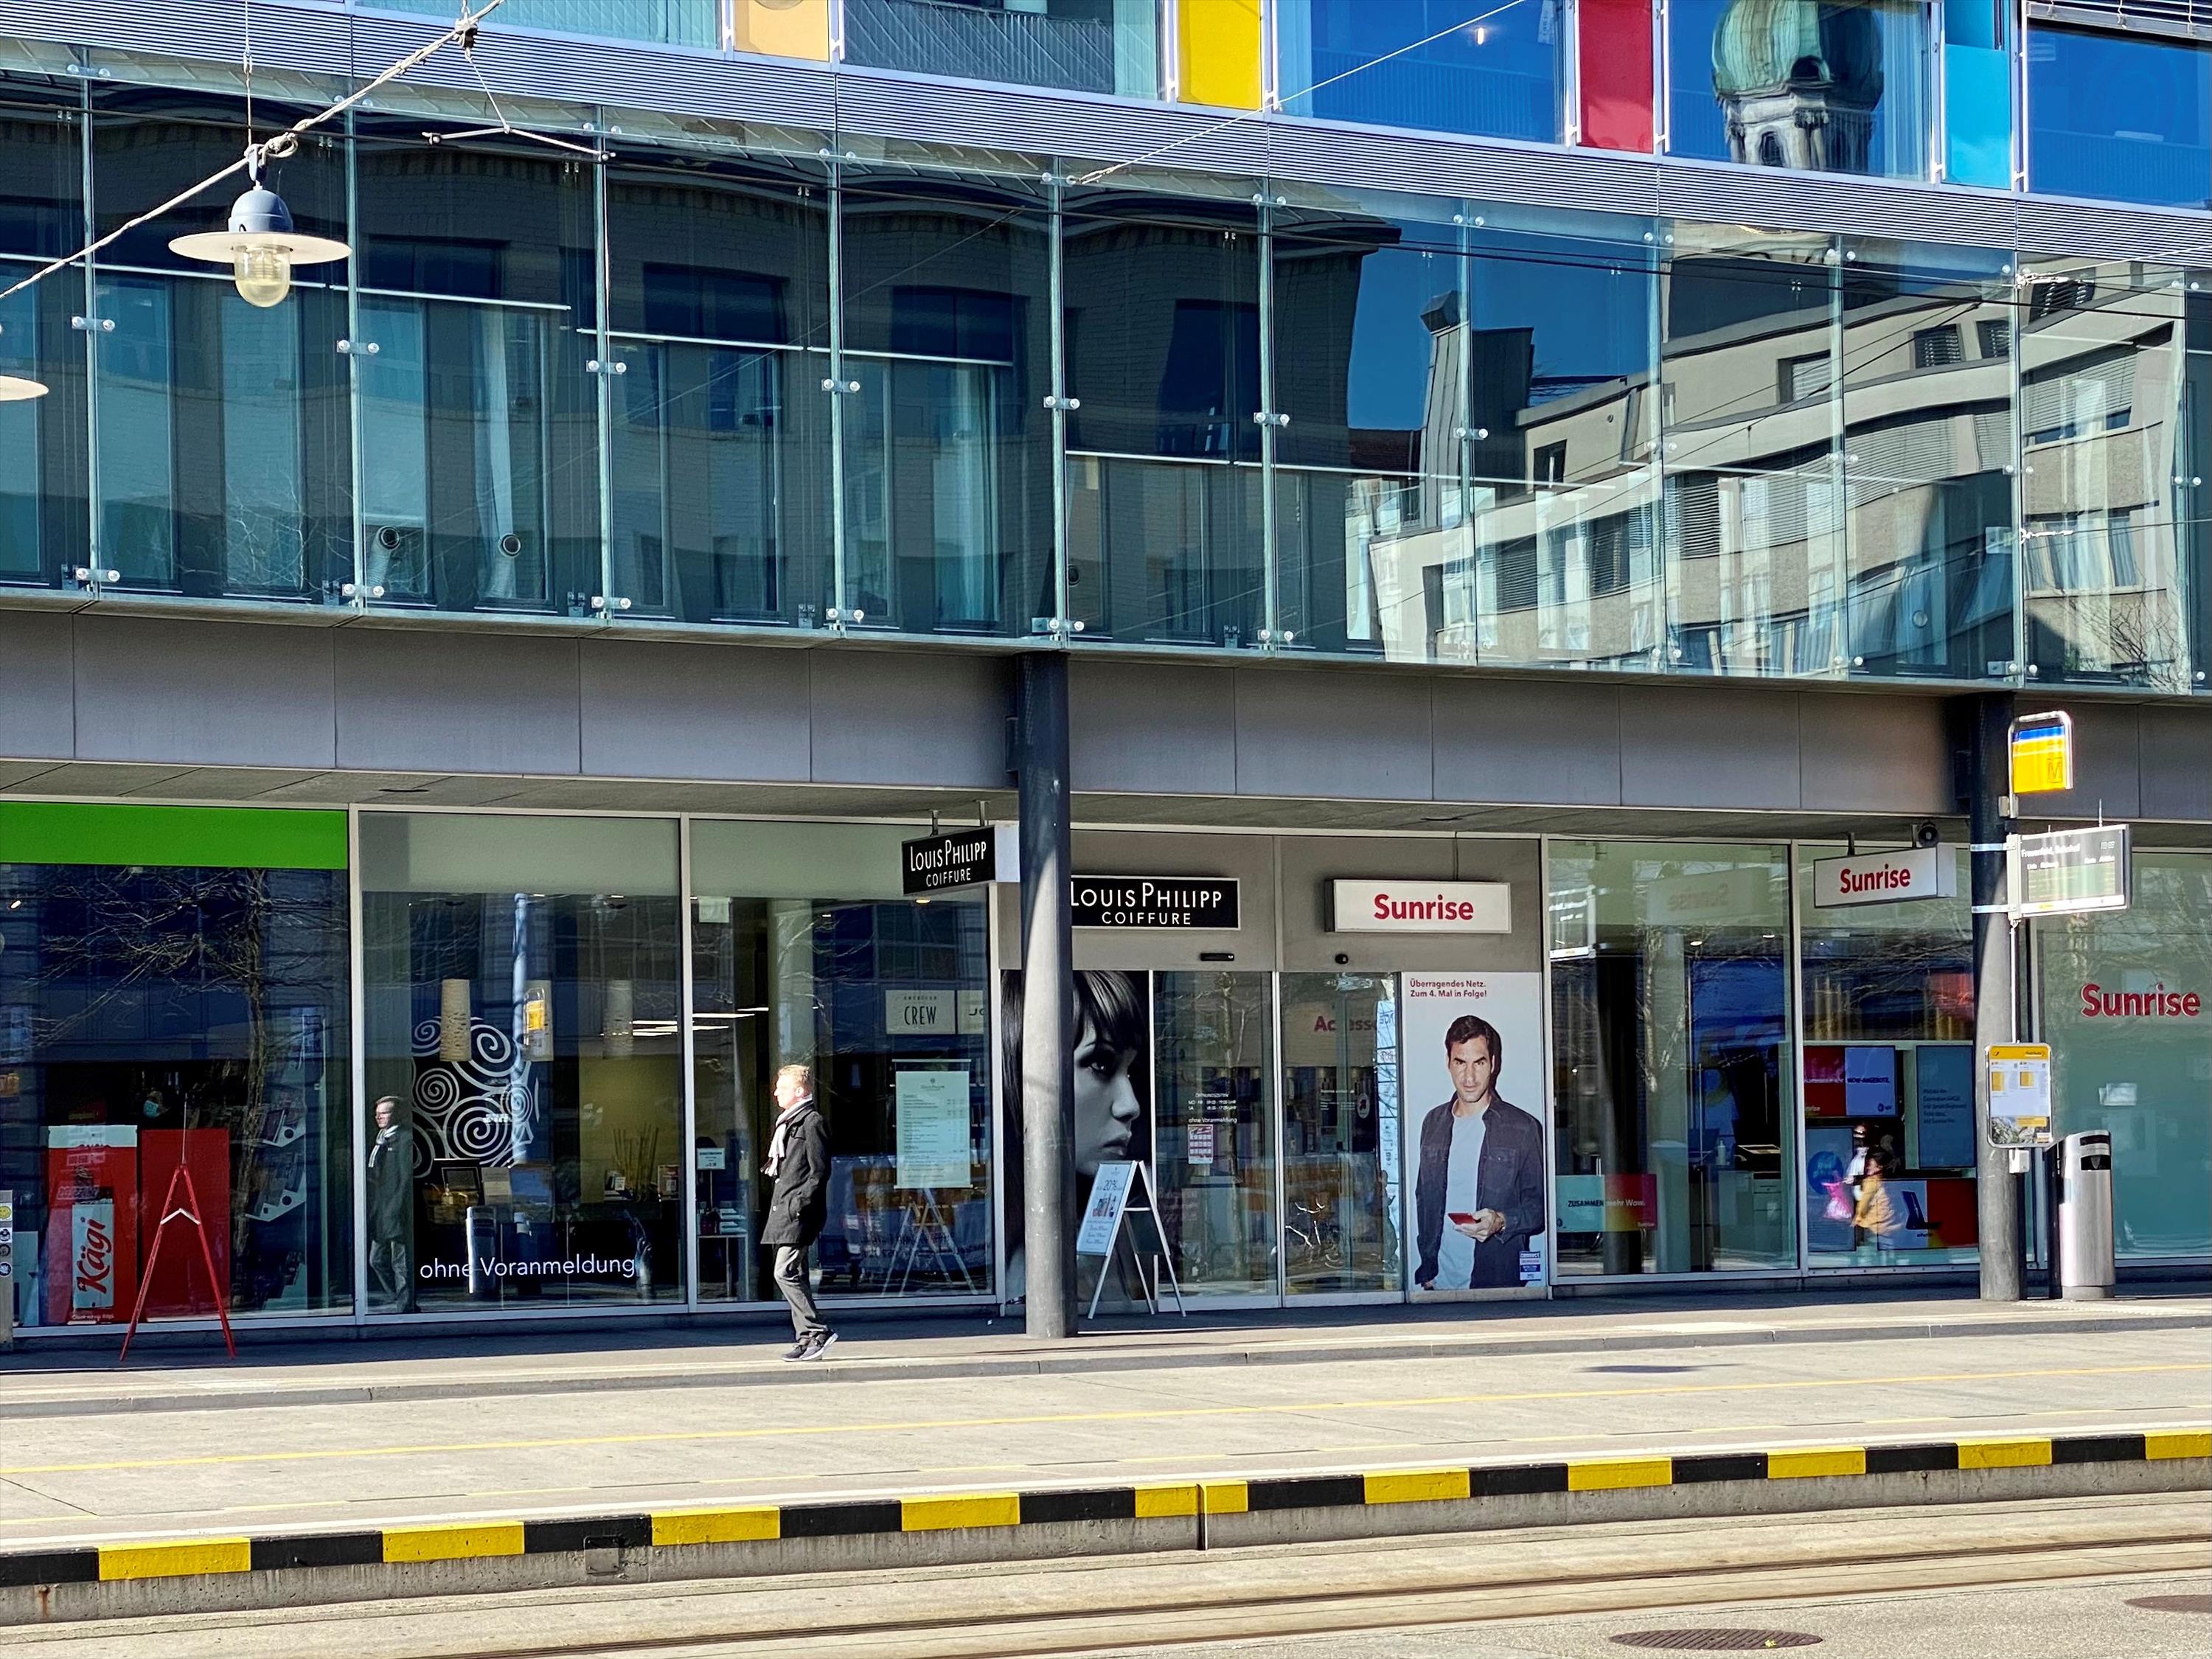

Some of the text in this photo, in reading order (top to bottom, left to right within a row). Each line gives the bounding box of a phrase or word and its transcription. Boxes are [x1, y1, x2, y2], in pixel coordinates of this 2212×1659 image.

[910, 839, 987, 872] LOUIS PHILIPP
[925, 868, 972, 887] COIFFURE
[1840, 863, 1911, 894] Sunrise
[1071, 880, 1222, 908] LOUIS PHILIPP
[1374, 893, 1474, 921] Sunrise
[1101, 911, 1192, 925] COIFFURE
[1409, 978, 1486, 990] Überragendes Netz.
[1410, 990, 1427, 998] Zum
[1438, 990, 1453, 998] Mal
[1454, 990, 1462, 998] in
[1463, 990, 1487, 999] Folge!
[2080, 981, 2201, 1018] Sunrise
[904, 1006, 937, 1026] CREW
[76, 1217, 111, 1294] Kägi
[420, 1253, 636, 1279] ohne Voranmeldung
